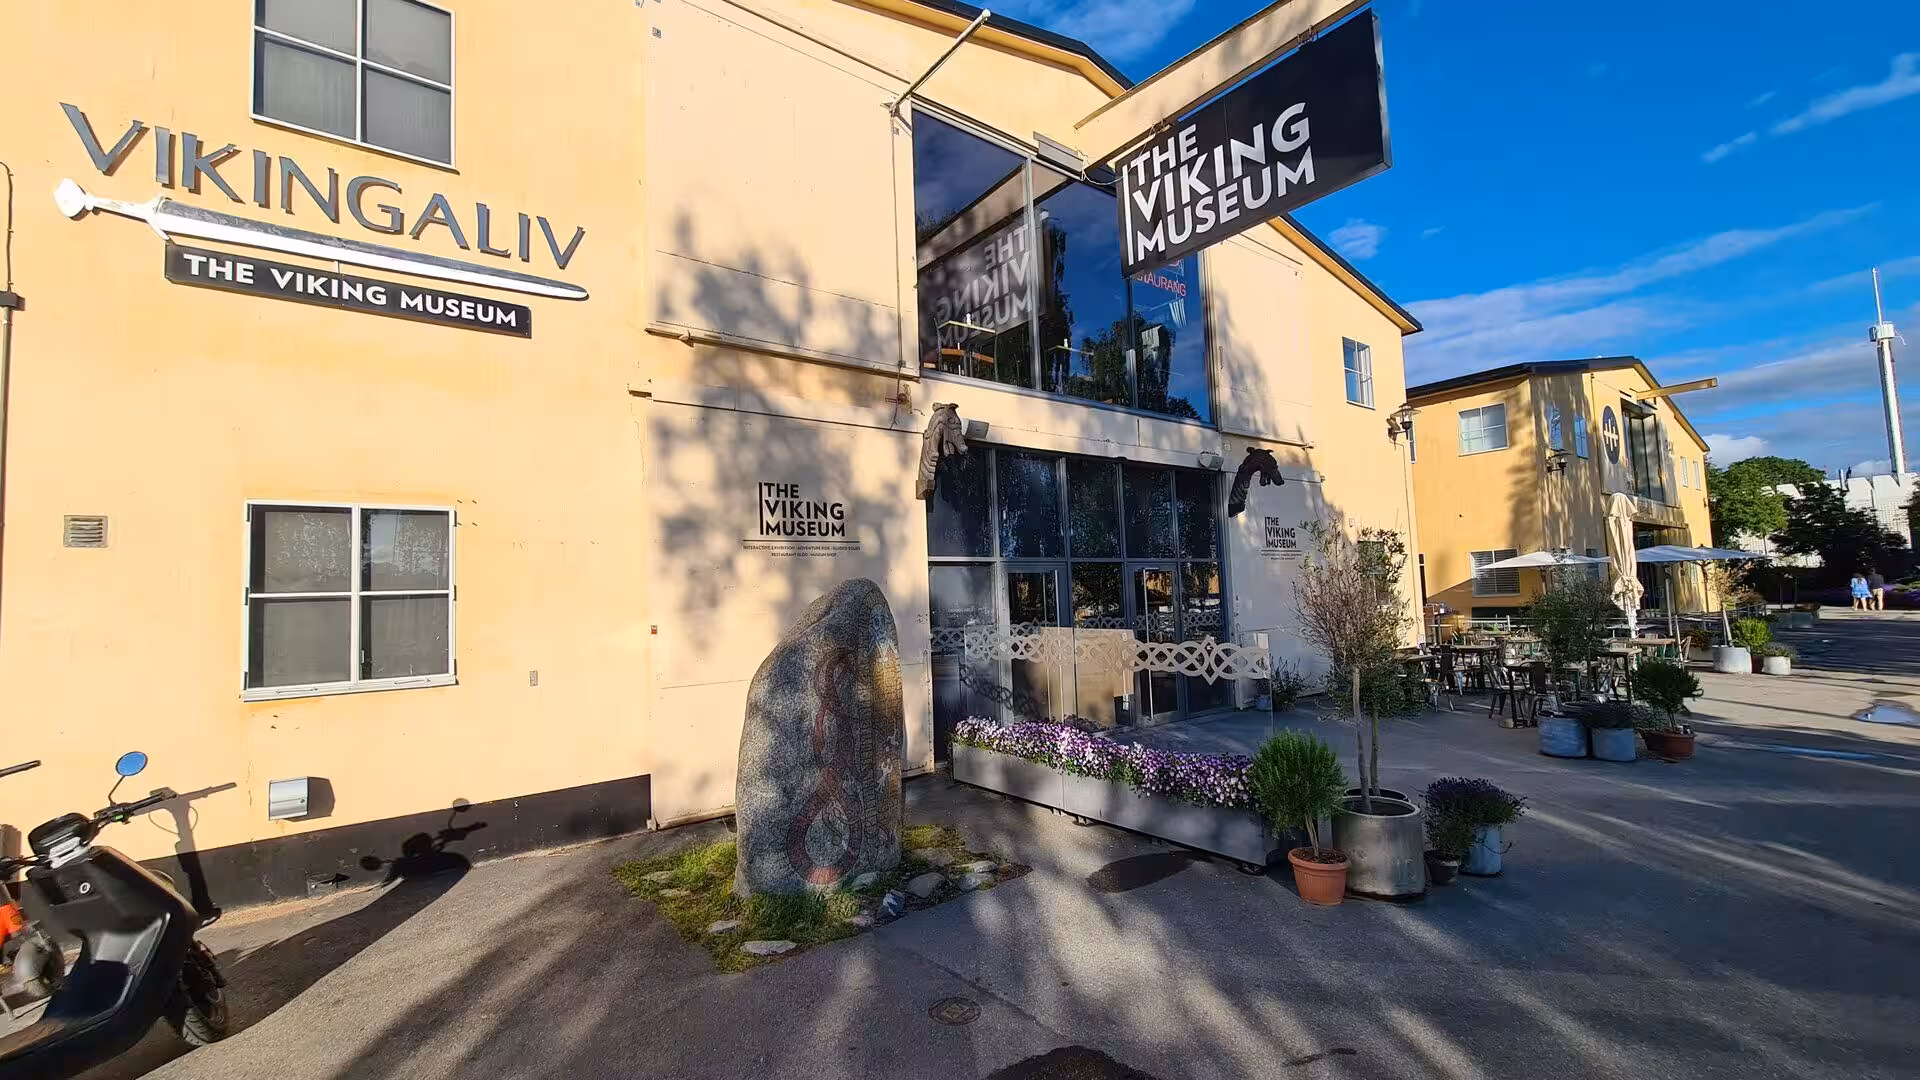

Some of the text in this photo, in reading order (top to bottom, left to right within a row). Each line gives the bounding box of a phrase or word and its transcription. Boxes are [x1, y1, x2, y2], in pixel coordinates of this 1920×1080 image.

[1132, 124, 1199, 187] THE
[1132, 102, 1310, 223] VIKING
[60, 102, 584, 269] VIKINGALIV
[1136, 146, 1316, 263] MUSEUM
[183, 253, 517, 328] THE VIKING MUSEUM
[763, 482, 799, 499] THE
[764, 500, 845, 520] VIKING
[766, 520, 845, 537] MUSEUM
[1266, 517, 1279, 526] THE
[1267, 527, 1296, 538] VIKING
[1268, 539, 1297, 548] MUSEUM
